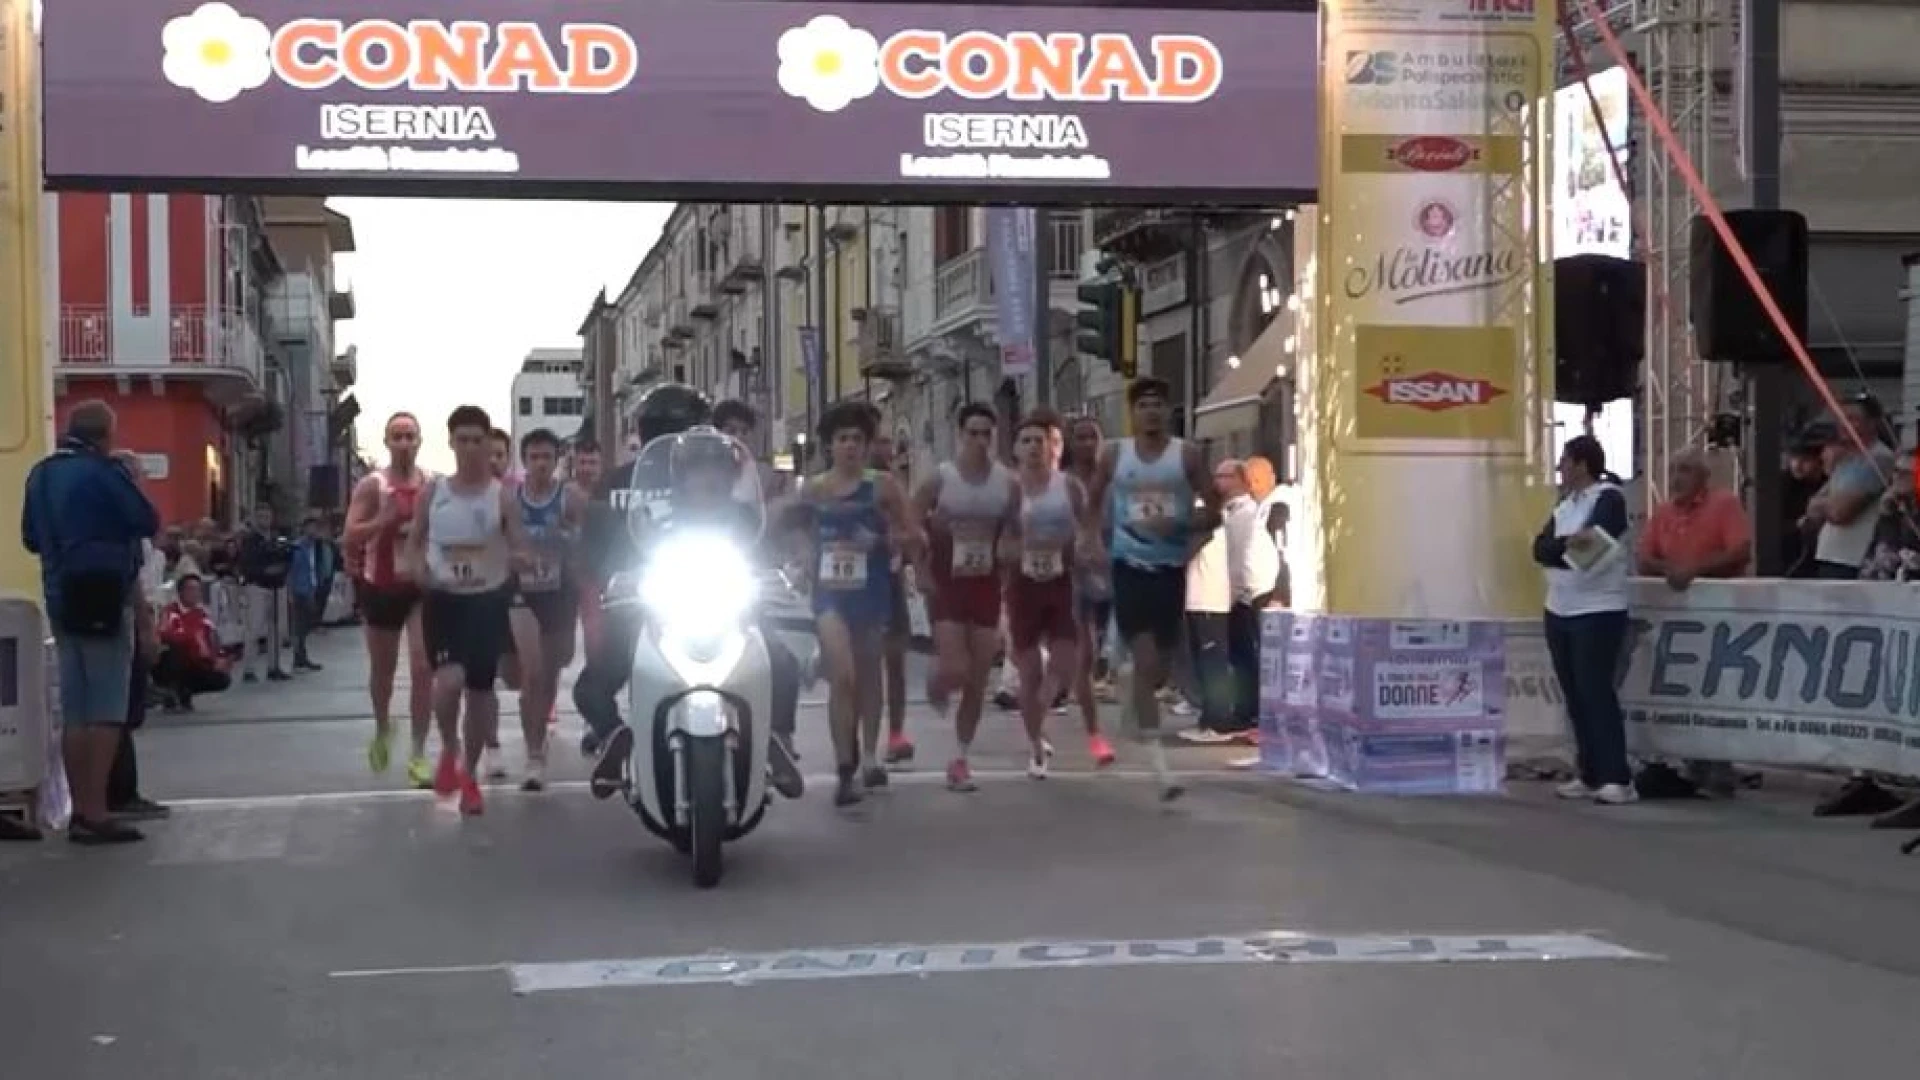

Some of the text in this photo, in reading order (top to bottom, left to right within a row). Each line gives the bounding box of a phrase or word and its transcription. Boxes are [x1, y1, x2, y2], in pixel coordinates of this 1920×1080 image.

[274, 22, 634, 90] CONAD
[881, 32, 1220, 101] CONAD
[323, 106, 492, 137] ISERNIA
[926, 115, 1085, 146] ISERNIA
[1345, 247, 1516, 299] Molisana
[1389, 381, 1481, 404] ISSAN
[1379, 684, 1440, 706] DONNE
